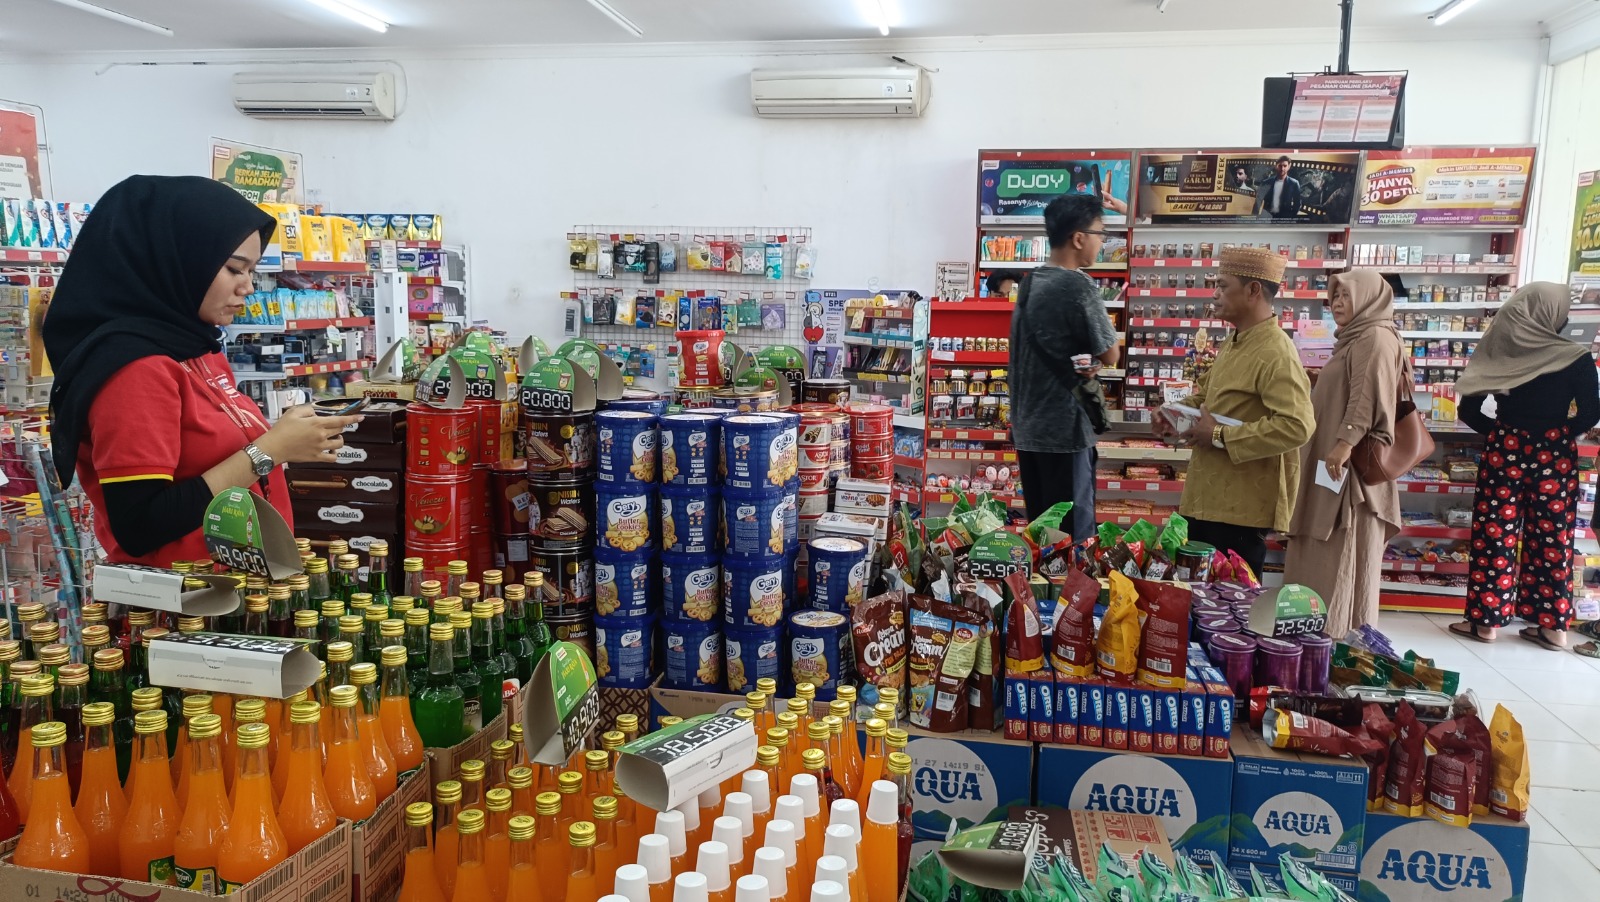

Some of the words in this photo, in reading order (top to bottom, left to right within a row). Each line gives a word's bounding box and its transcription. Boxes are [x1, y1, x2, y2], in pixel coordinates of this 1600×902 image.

[365, 88, 370, 96] 2
[234, 176, 280, 187] RAMADHAN
[235, 168, 260, 177] BERKAH
[1008, 174, 1064, 188] DJOY
[1216, 157, 1225, 190] KRETEK
[1368, 177, 1412, 191] HANYA
[1361, 191, 1380, 206] 30
[1383, 187, 1421, 199] DETIK
[522, 390, 570, 410] 20.800
[560, 490, 580, 498] NISSIN
[222, 506, 233, 515] HARI
[234, 509, 245, 517] RAYA
[614, 501, 640, 517] Gery
[211, 524, 220, 532] ABC
[215, 544, 268, 576] 18.900
[691, 572, 715, 588] Gery
[756, 576, 779, 593] Gery
[1276, 618, 1325, 635] 32.500
[795, 640, 818, 657] Gery
[1016, 682, 1027, 714] OREO
[1040, 685, 1052, 717] OREO
[1067, 687, 1078, 719] OREO
[1092, 689, 1102, 721] OREO
[1116, 692, 1128, 724] OREO
[1141, 694, 1152, 727] OREO
[1167, 696, 1178, 728] OREO
[1193, 698, 1204, 730] OREO
[1221, 700, 1231, 733] OREO
[914, 767, 982, 803] QUA
[1085, 783, 1181, 817] AQUA
[1264, 810, 1331, 836] AQUA
[310, 863, 340, 886] Strawberry
[1377, 848, 1491, 892] AQUA
[26, 884, 39, 897] 01
[56, 887, 88, 902] 14:23
